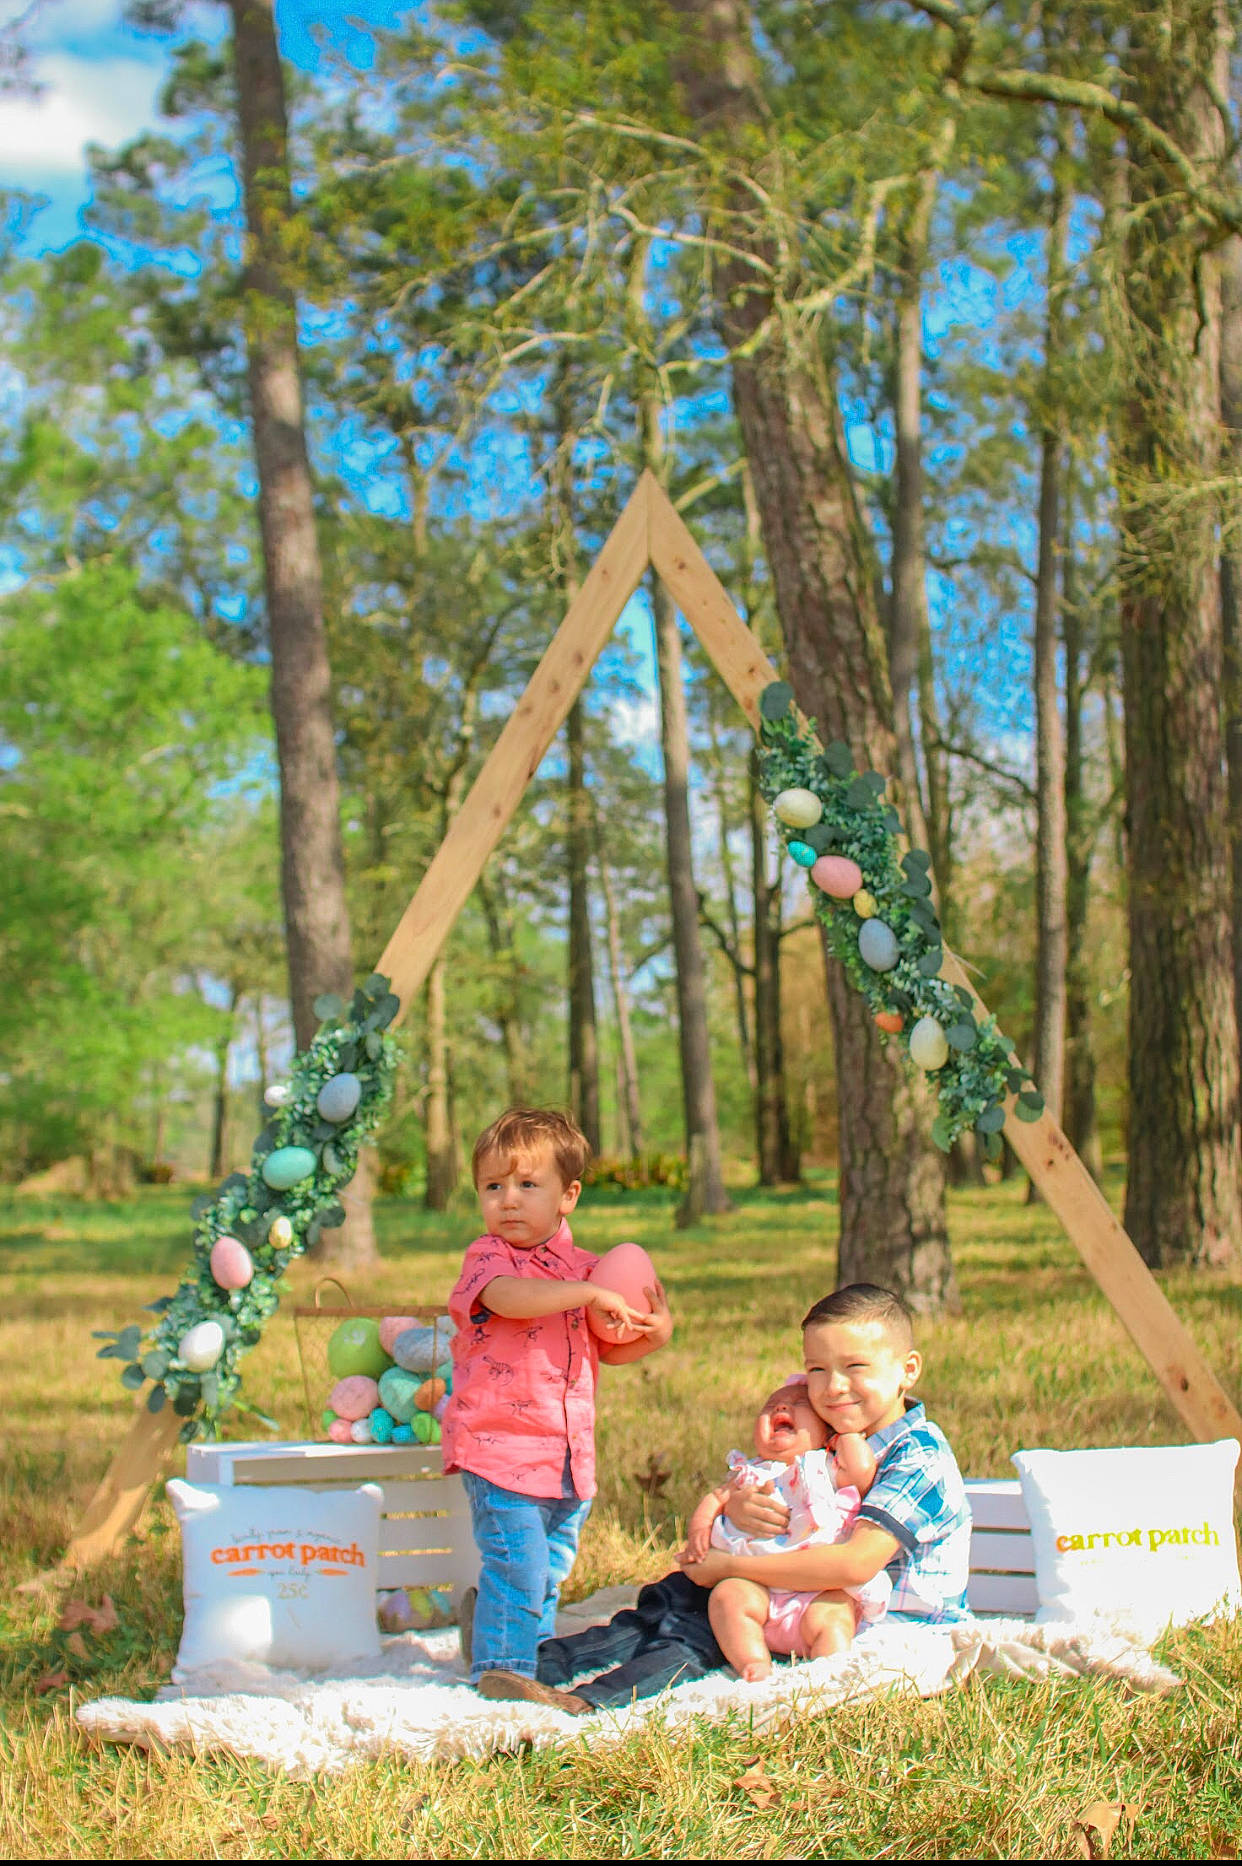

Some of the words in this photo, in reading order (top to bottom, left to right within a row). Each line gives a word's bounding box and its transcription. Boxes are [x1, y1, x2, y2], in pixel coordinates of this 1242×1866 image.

[1056, 1528, 1142, 1553] carrot
[1147, 1521, 1220, 1552] patch
[210, 1542, 296, 1564] carrot
[300, 1541, 367, 1568] patch
